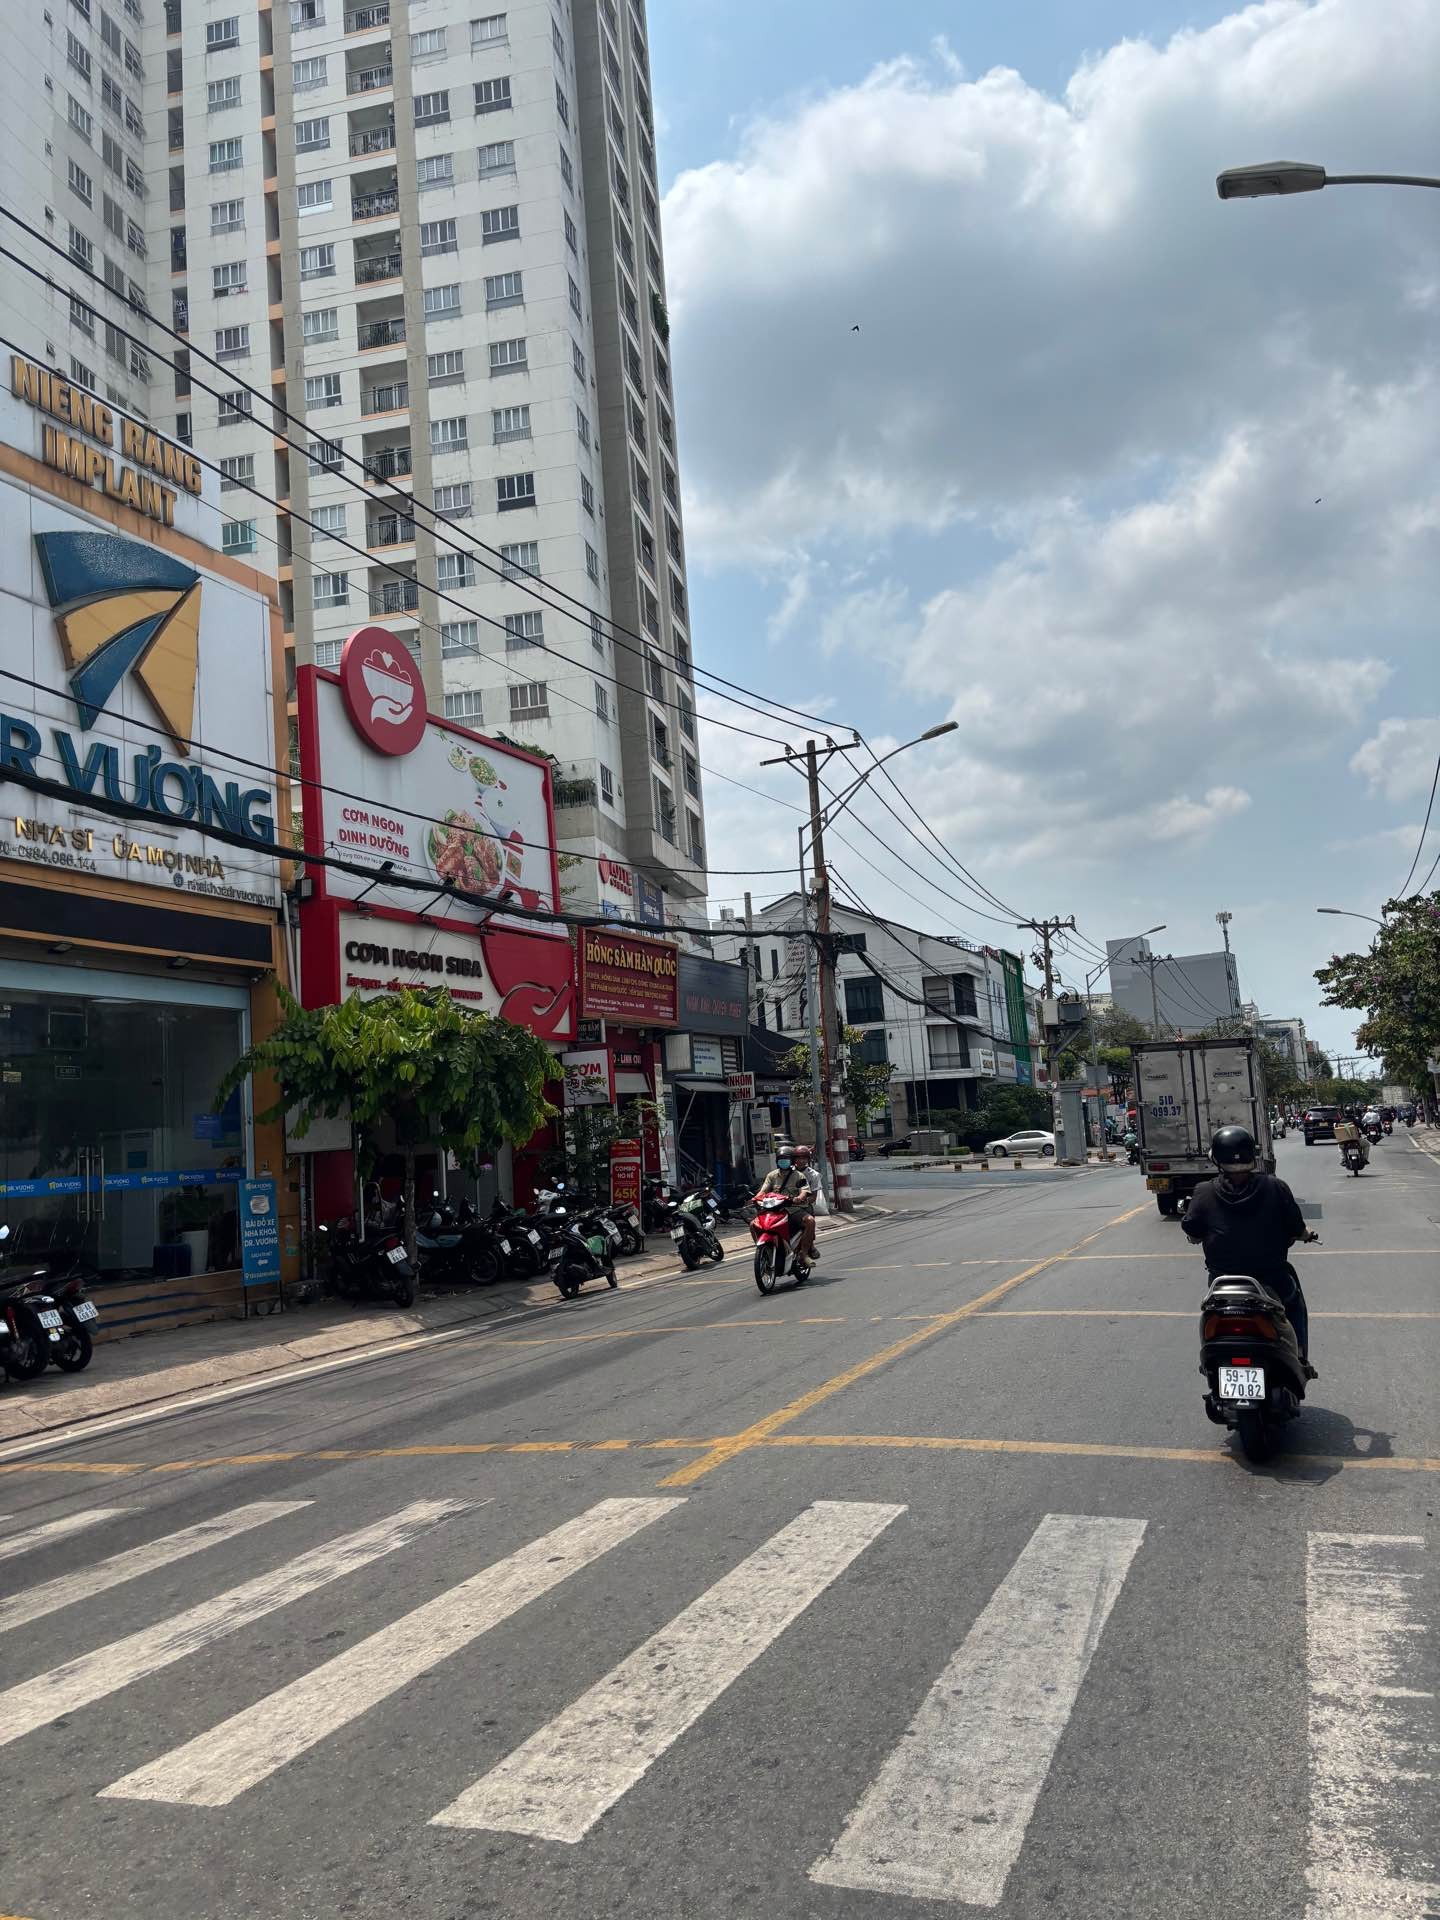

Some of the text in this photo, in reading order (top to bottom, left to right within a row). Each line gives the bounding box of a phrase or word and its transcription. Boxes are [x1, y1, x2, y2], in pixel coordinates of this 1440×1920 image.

[43, 423, 177, 527] IMPLANT
[55, 731, 275, 844] VƯƠNG
[342, 807, 404, 836] CƠM NGON
[14, 815, 66, 847] NHA
[147, 844, 183, 874] MỌI
[185, 854, 225, 880] NHÀ
[338, 828, 367, 845] DINH
[369, 834, 410, 858] DƯỠNG
[345, 940, 483, 978] CƠM NGON SIBA
[586, 935, 677, 979] HỒNG SÂM HÀN QUỐC
[1158, 1095, 1174, 1106] 51D
[614, 1187, 638, 1200] 45K
[259, 1228, 277, 1236] KHOA
[267, 1218, 275, 1226] XE
[1223, 1383, 1262, 1398] 470.82
[1226, 1369, 1258, 1384] 59-T2
